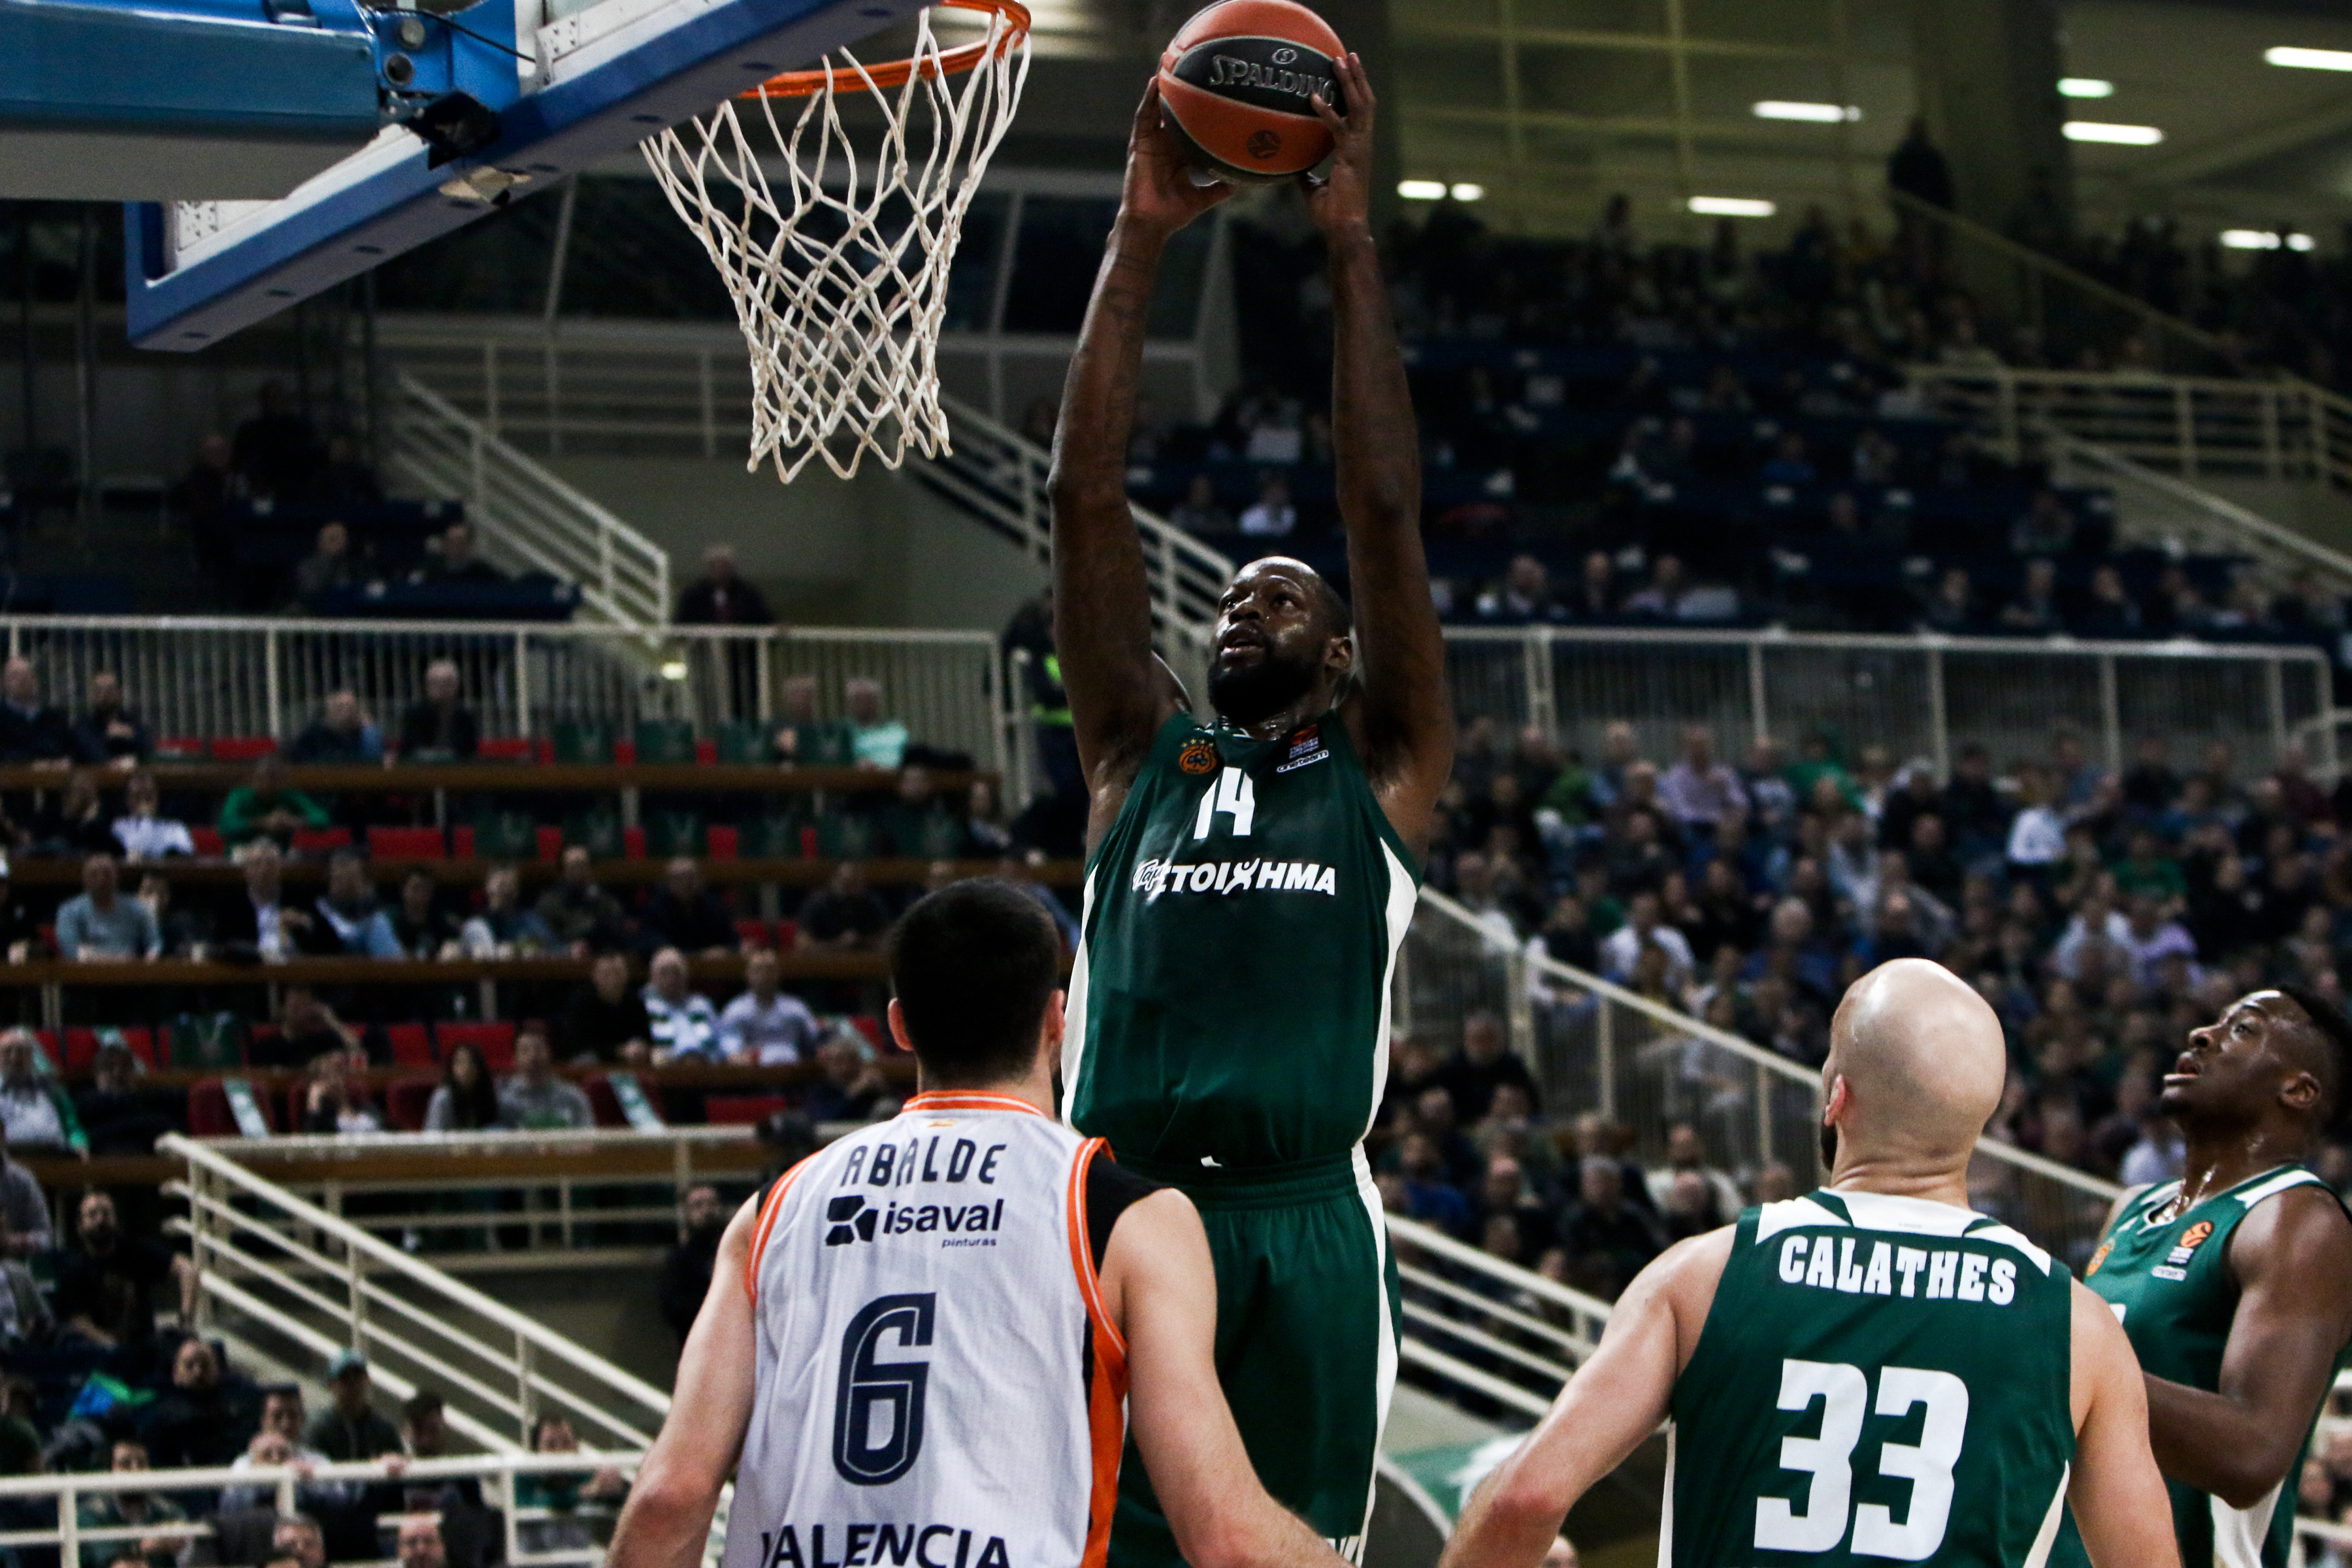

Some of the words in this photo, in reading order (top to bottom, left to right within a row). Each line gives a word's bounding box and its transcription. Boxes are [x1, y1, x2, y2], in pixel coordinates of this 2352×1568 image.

[1209, 54, 1335, 107] SPALDING
[1193, 766, 1255, 840] 14
[840, 1135, 1007, 1188] ABALDE
[882, 1199, 1004, 1234] isaval
[941, 1237, 997, 1249] pinturas
[1778, 1234, 2017, 1305] CALATHES
[832, 1292, 936, 1486] 6
[1754, 1358, 1969, 1561] 33
